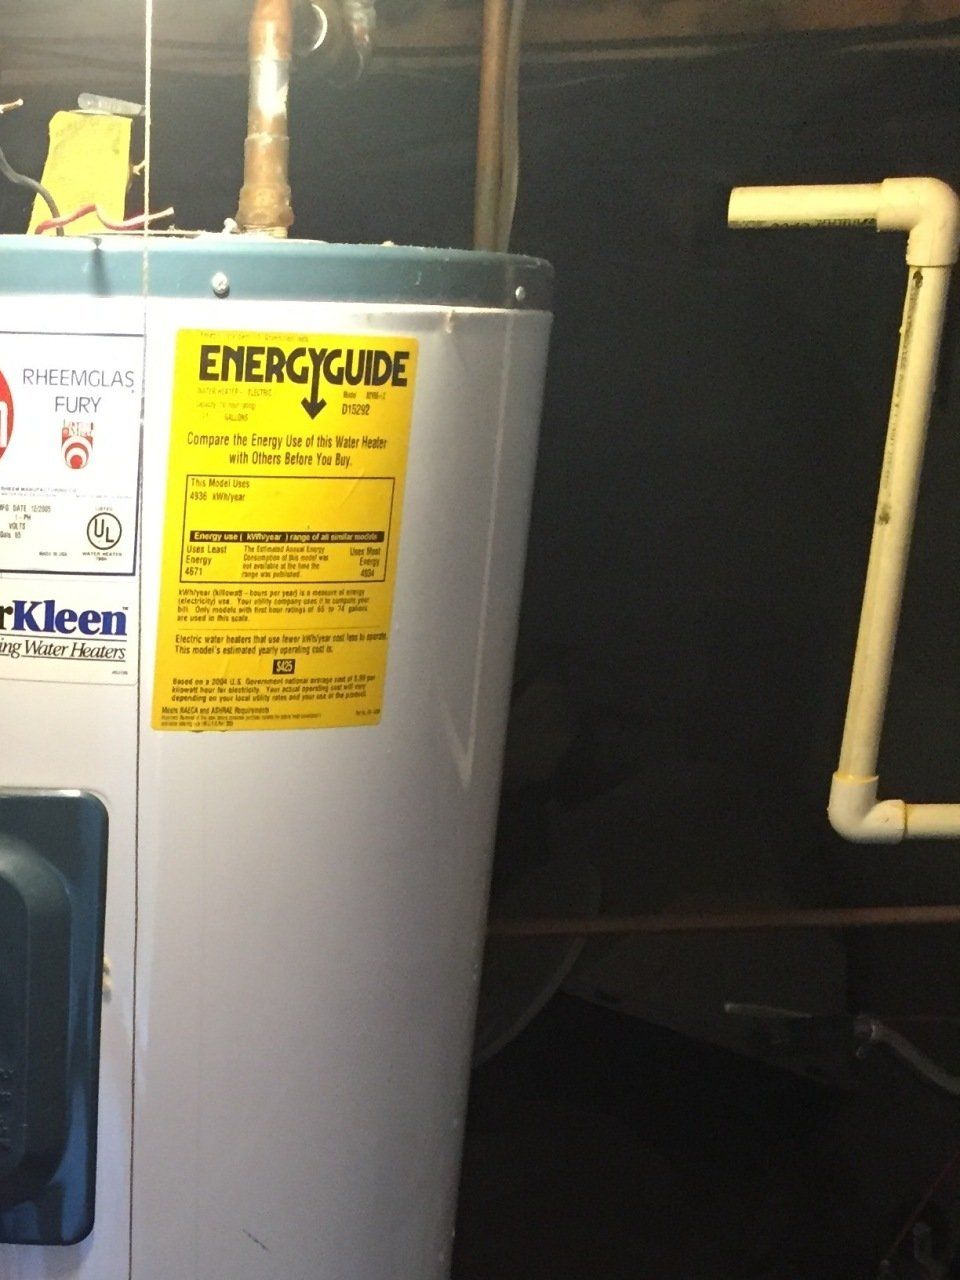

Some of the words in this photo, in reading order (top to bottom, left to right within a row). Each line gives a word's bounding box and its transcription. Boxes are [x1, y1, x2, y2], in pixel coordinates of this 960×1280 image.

[22, 368, 135, 388] RHEEMGLAS
[54, 396, 102, 414] FURY
[342, 404, 371, 415] D15292
[187, 431, 229, 448] Compare
[233, 433, 247, 446] the
[251, 433, 283, 450] Energy
[286, 434, 302, 447] Use
[305, 434, 314, 447] of
[316, 435, 332, 448] this
[335, 435, 359, 449] Water
[362, 435, 387, 449] Heater
[229, 451, 248, 464] with
[252, 450, 281, 465] Others
[285, 451, 313, 465] Before
[317, 452, 332, 466] You
[335, 452, 352, 469] Buy.
[191, 478, 206, 487] This
[209, 478, 230, 487] Model
[232, 479, 250, 488] Uses
[190, 491, 207, 501] 4936
[213, 492, 245, 503] kWh/year
[8, 522, 25, 530] VOLTS
[94, 518, 114, 543] UL
[194, 532, 222, 541] Energy
[246, 533, 282, 542] kWh/year
[290, 533, 310, 542] range
[186, 545, 204, 553] Uses
[207, 545, 227, 553] Least
[306, 546, 325, 554] Energy
[350, 547, 364, 556] Uses
[366, 547, 381, 555] Most
[186, 554, 212, 566] Energy
[243, 554, 280, 562] Consumption
[360, 557, 380, 567] Energy
[185, 567, 203, 576] 4671
[175, 634, 202, 643] Electric
[204, 635, 224, 643] water
[226, 635, 252, 644] heaters
[253, 635, 266, 643] that
[282, 634, 300, 643] fewer
[24, 639, 68, 658] Water
[70, 642, 126, 660] Heaters
[175, 645, 191, 654] This
[192, 645, 221, 654] model's
[222, 646, 256, 655] estimated
[258, 646, 278, 656] yearly
[279, 645, 311, 655] operating
[312, 645, 325, 653] cost
[276, 660, 293, 673] $425
[245, 677, 283, 685] Government
